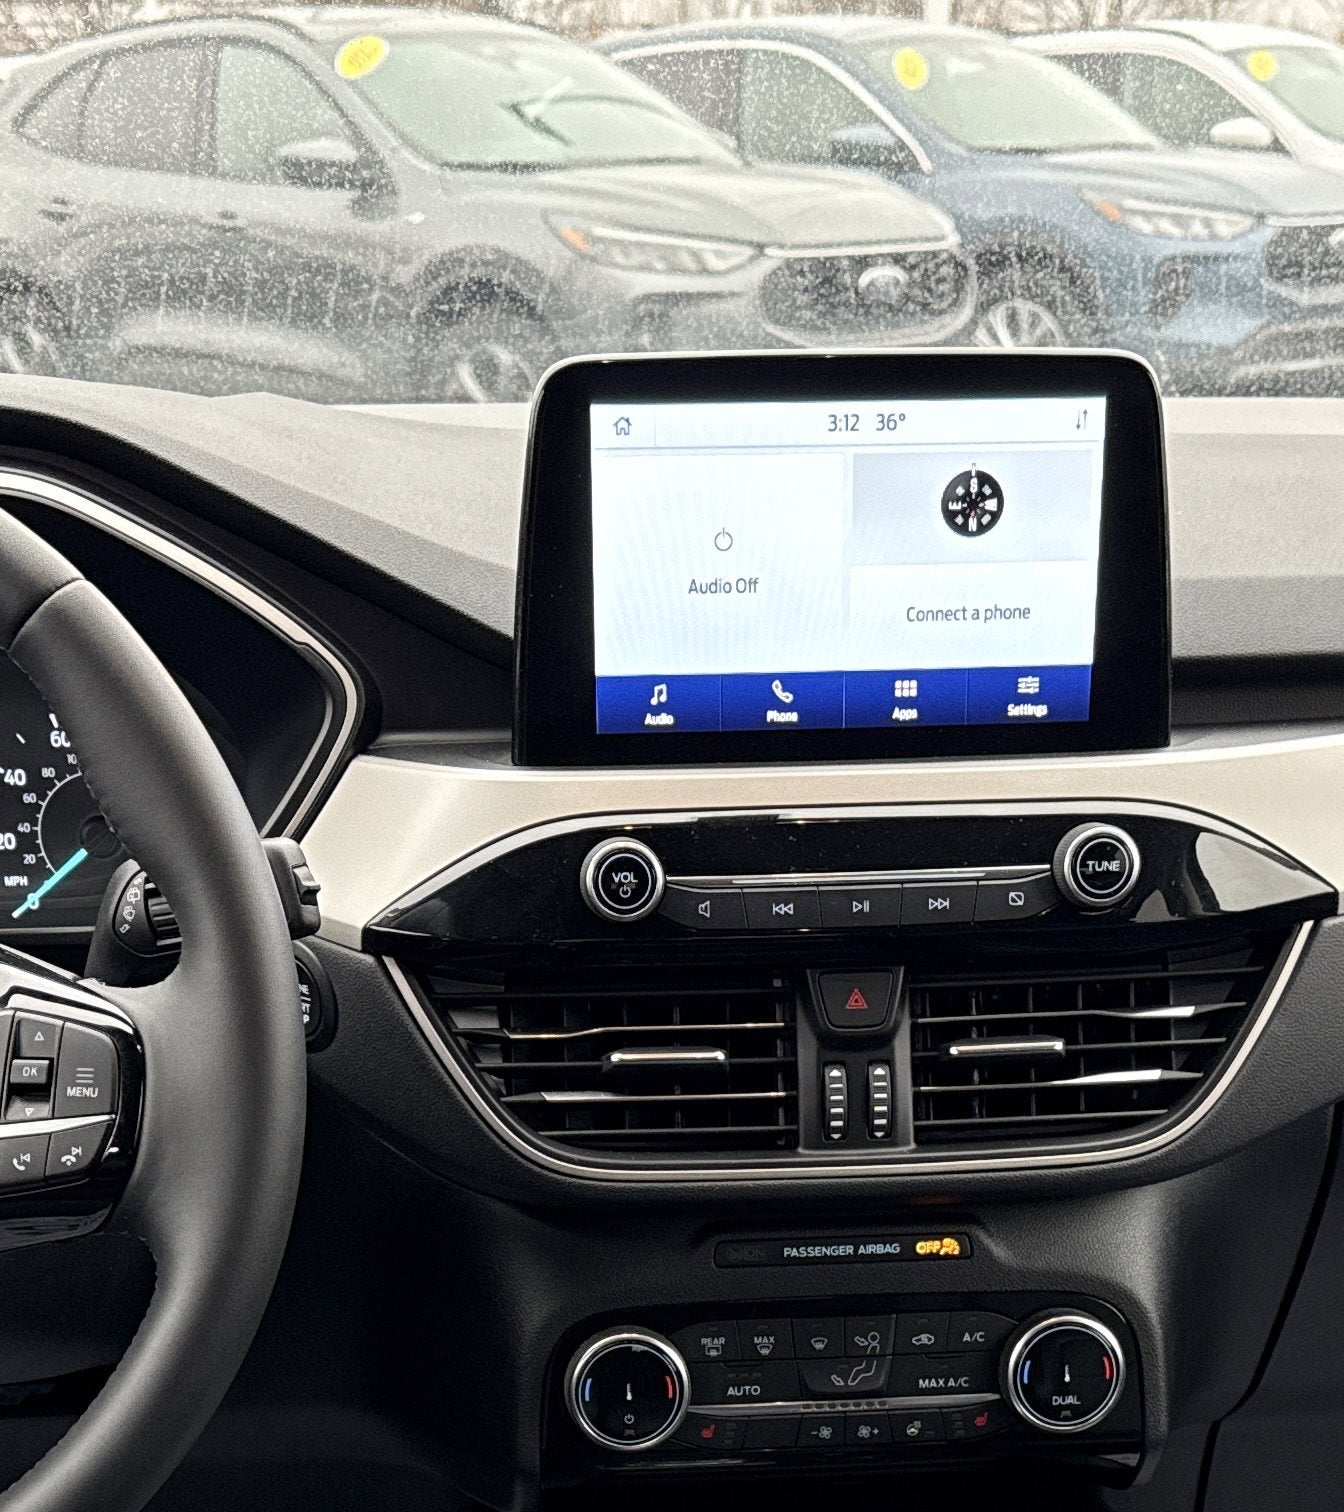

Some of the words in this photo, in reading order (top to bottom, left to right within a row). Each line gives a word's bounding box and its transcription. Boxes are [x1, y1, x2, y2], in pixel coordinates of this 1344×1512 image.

[828, 413, 860, 433] 3:12
[875, 412, 906, 432] 36°
[688, 576, 732, 596] Audio
[734, 576, 760, 595] Off
[906, 604, 971, 623] Connect
[972, 609, 982, 622] a
[983, 603, 1031, 624] phone
[766, 709, 798, 724] Phone
[892, 706, 918, 722] Apps
[1007, 702, 1048, 718] Settings
[644, 711, 674, 727] Audio
[4, 768, 27, 786] 40
[41, 767, 56, 779] 80
[22, 793, 37, 804] 60
[17, 822, 31, 834] 40
[23, 854, 36, 865] 20
[1086, 860, 1121, 872] TUNE
[4, 876, 28, 888] MPH
[611, 871, 639, 884] VOL
[22, 1066, 38, 1078] OK
[66, 1086, 99, 1099] MENU
[783, 1244, 854, 1258] PASSENGER
[857, 1243, 901, 1256] AIRBAG
[915, 1240, 941, 1255] OFF
[701, 1336, 726, 1346] REAR
[753, 1335, 775, 1344] MAX
[962, 1331, 985, 1342] A/C
[918, 1377, 945, 1389] MAX
[947, 1376, 970, 1388] A/C
[727, 1385, 761, 1397] AUTO
[1052, 1395, 1081, 1406] DUAL
